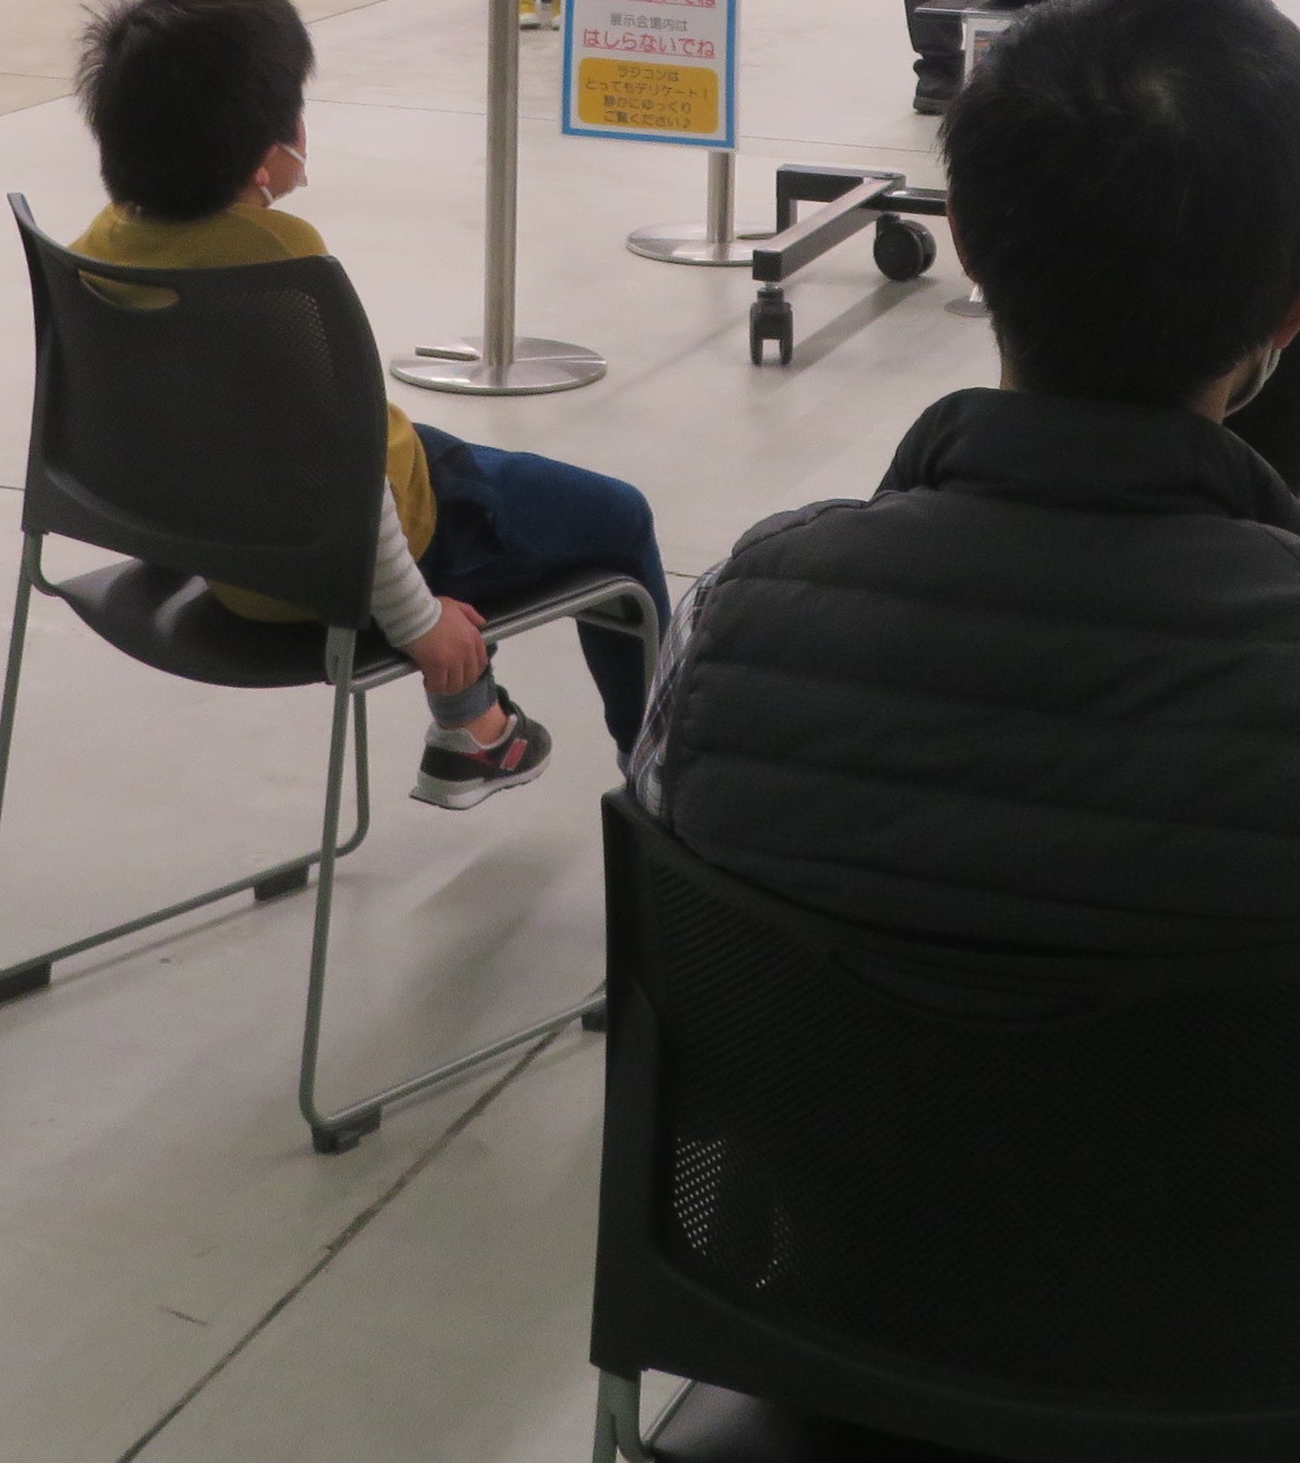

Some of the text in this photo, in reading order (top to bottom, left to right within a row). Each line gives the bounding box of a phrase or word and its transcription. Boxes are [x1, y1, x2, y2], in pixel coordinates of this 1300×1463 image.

[583, 28, 717, 58] はしらないでね
